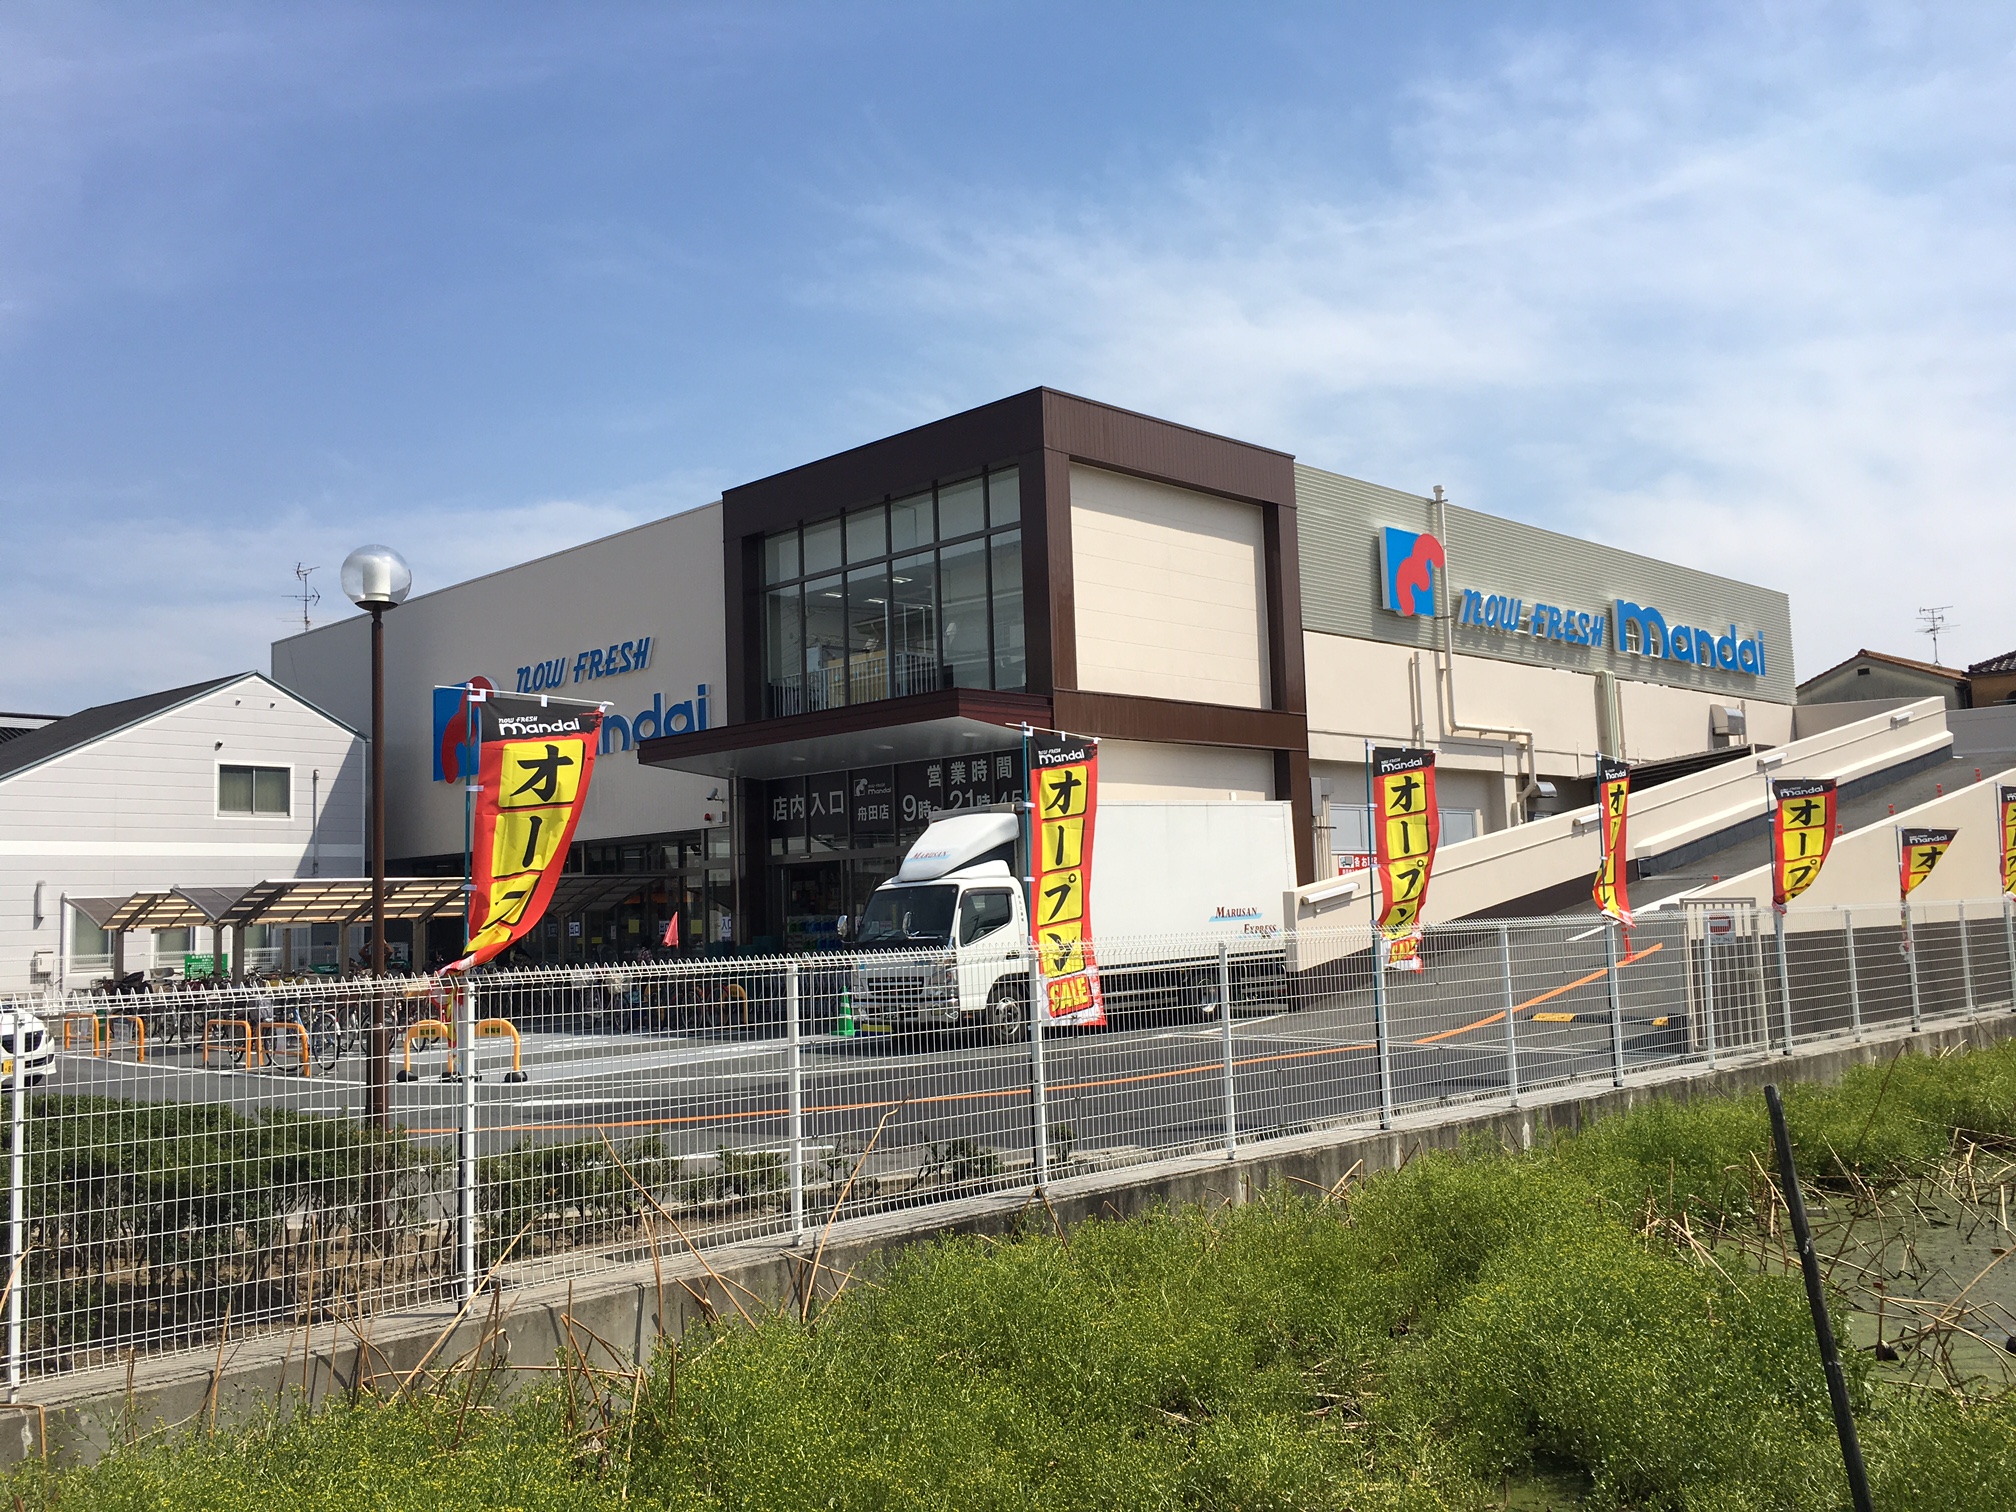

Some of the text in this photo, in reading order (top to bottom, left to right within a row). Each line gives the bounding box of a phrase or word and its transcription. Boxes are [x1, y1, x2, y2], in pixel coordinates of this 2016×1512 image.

[1528, 601, 1605, 647] FRESH
[1612, 598, 1766, 677] mandai
[573, 637, 653, 684] FRESH
[499, 718, 580, 736] mandai
[597, 683, 709, 755] ndai
[927, 755, 1013, 788] 営業時間
[1038, 748, 1085, 765] mandai
[1381, 757, 1423, 773] mandai
[773, 789, 844, 822] 店内入口
[1780, 785, 1824, 797] mandai
[857, 803, 890, 822] 舟田店
[1788, 799, 1821, 898] オープ
[1045, 769, 1082, 971] オープン
[1215, 906, 1258, 919] MARUSAN
[1243, 923, 1277, 935] EXPRESS
[1049, 977, 1089, 1012] SALE
